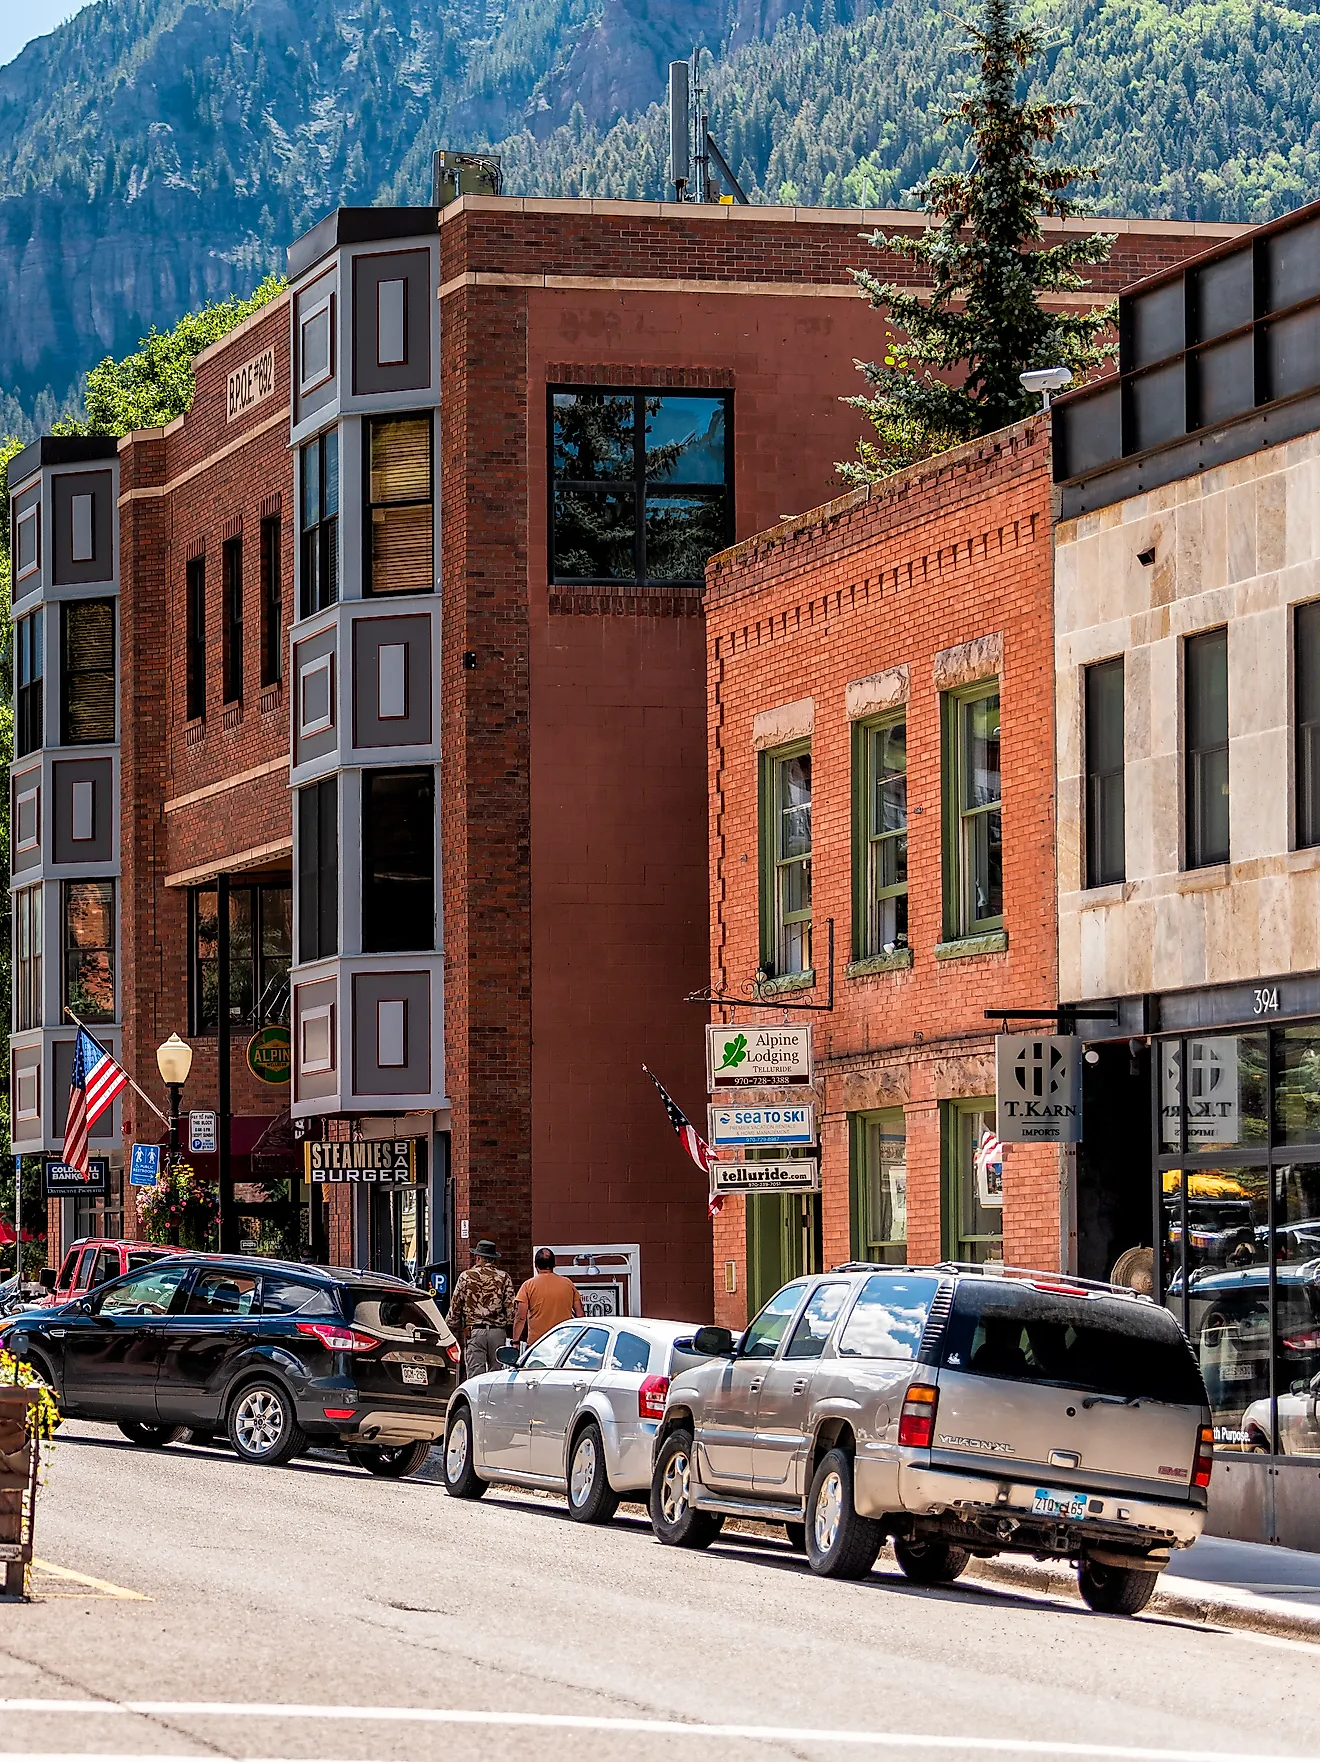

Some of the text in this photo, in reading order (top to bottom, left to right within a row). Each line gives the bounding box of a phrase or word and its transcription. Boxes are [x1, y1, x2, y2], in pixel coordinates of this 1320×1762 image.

[1253, 987, 1279, 1014] 394
[755, 1033, 799, 1049] Alpine
[746, 1049, 800, 1064] Lodging
[752, 1065, 793, 1074] TELLURIDE
[734, 1077, 790, 1085] 970-728-3388
[735, 1111, 805, 1124] sea TO SKI
[1021, 1128, 1061, 1136] IMPORTS
[312, 1142, 392, 1170] STEAMIES
[312, 1169, 409, 1182] BURGER
[435, 1275, 445, 1290] P
[1221, 1427, 1251, 1444] Purpose.
